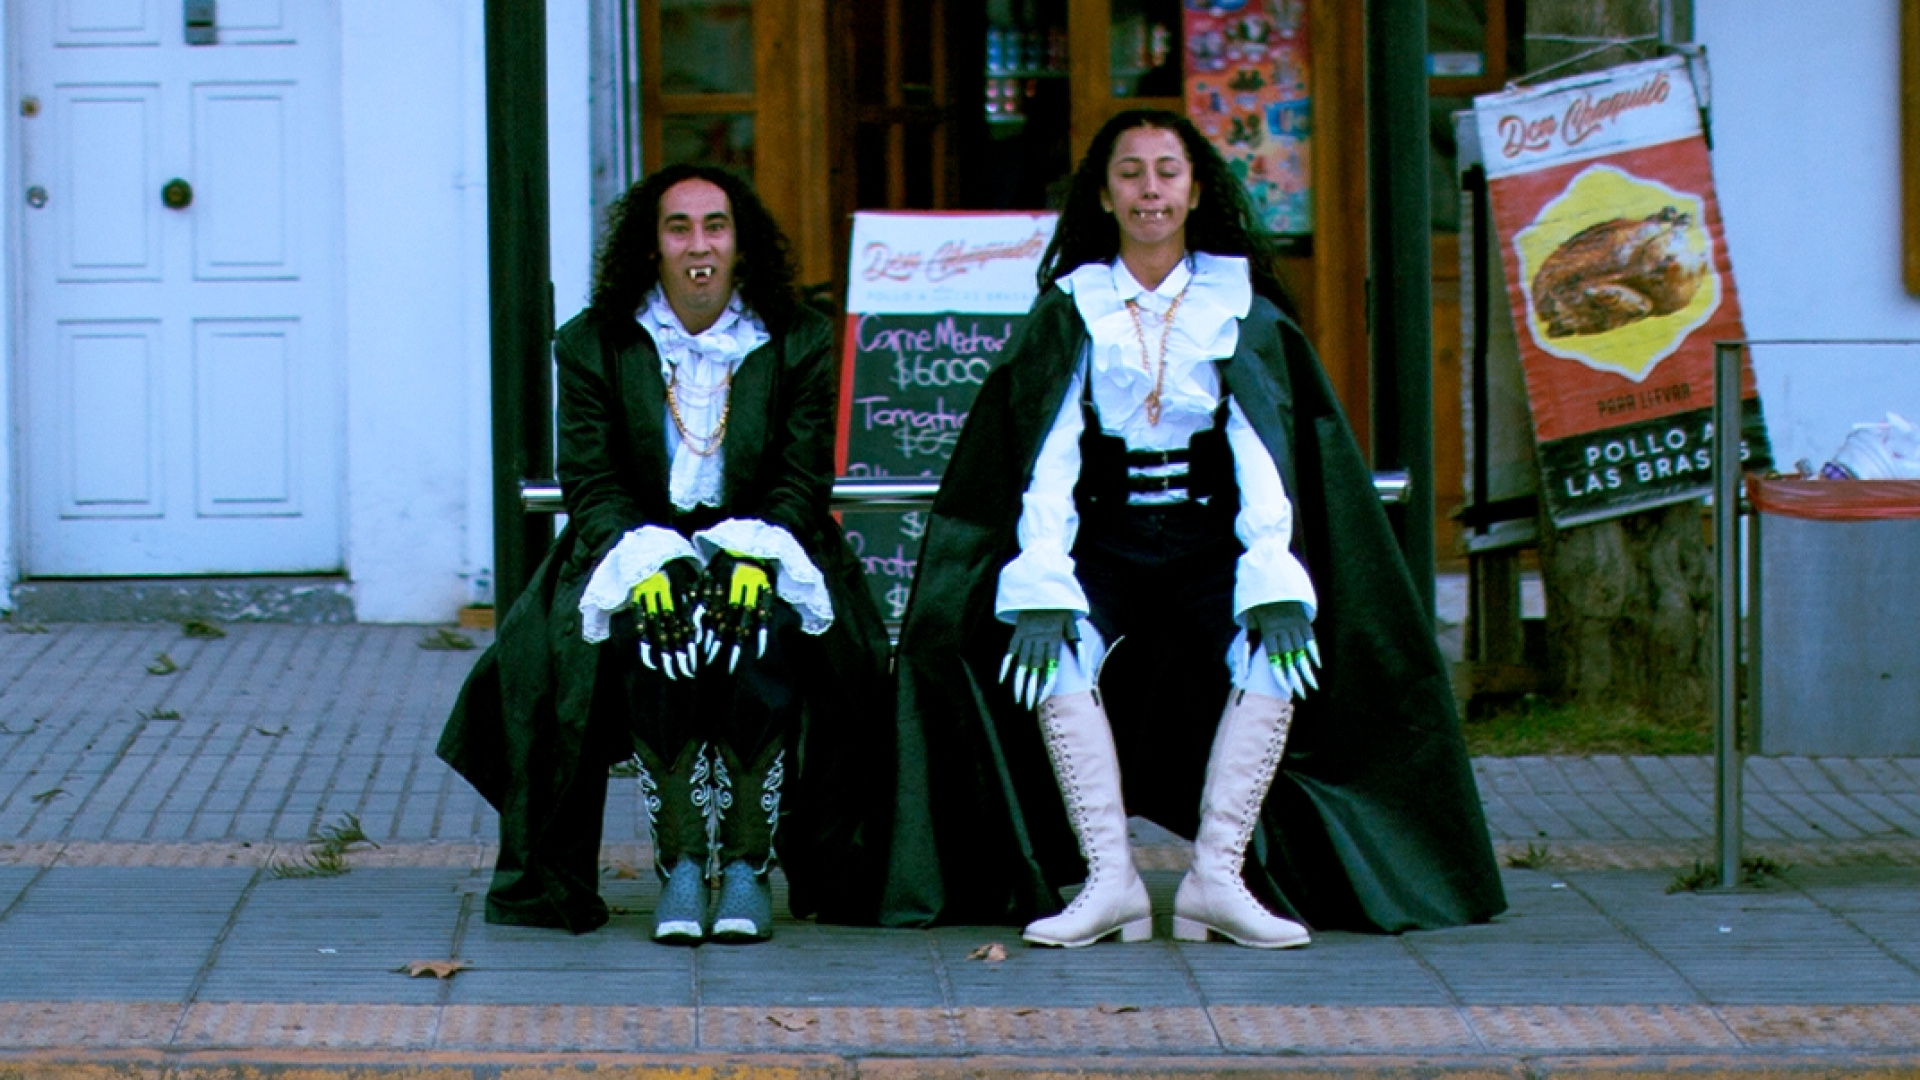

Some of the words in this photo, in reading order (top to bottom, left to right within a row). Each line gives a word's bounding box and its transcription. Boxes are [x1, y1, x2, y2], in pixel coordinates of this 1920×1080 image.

[1498, 115, 1556, 158] Don
[855, 314, 932, 352] Carne
[1584, 427, 1687, 467] POLLO
[1565, 467, 1623, 497] LAS
[1635, 440, 1751, 483] BRASS
